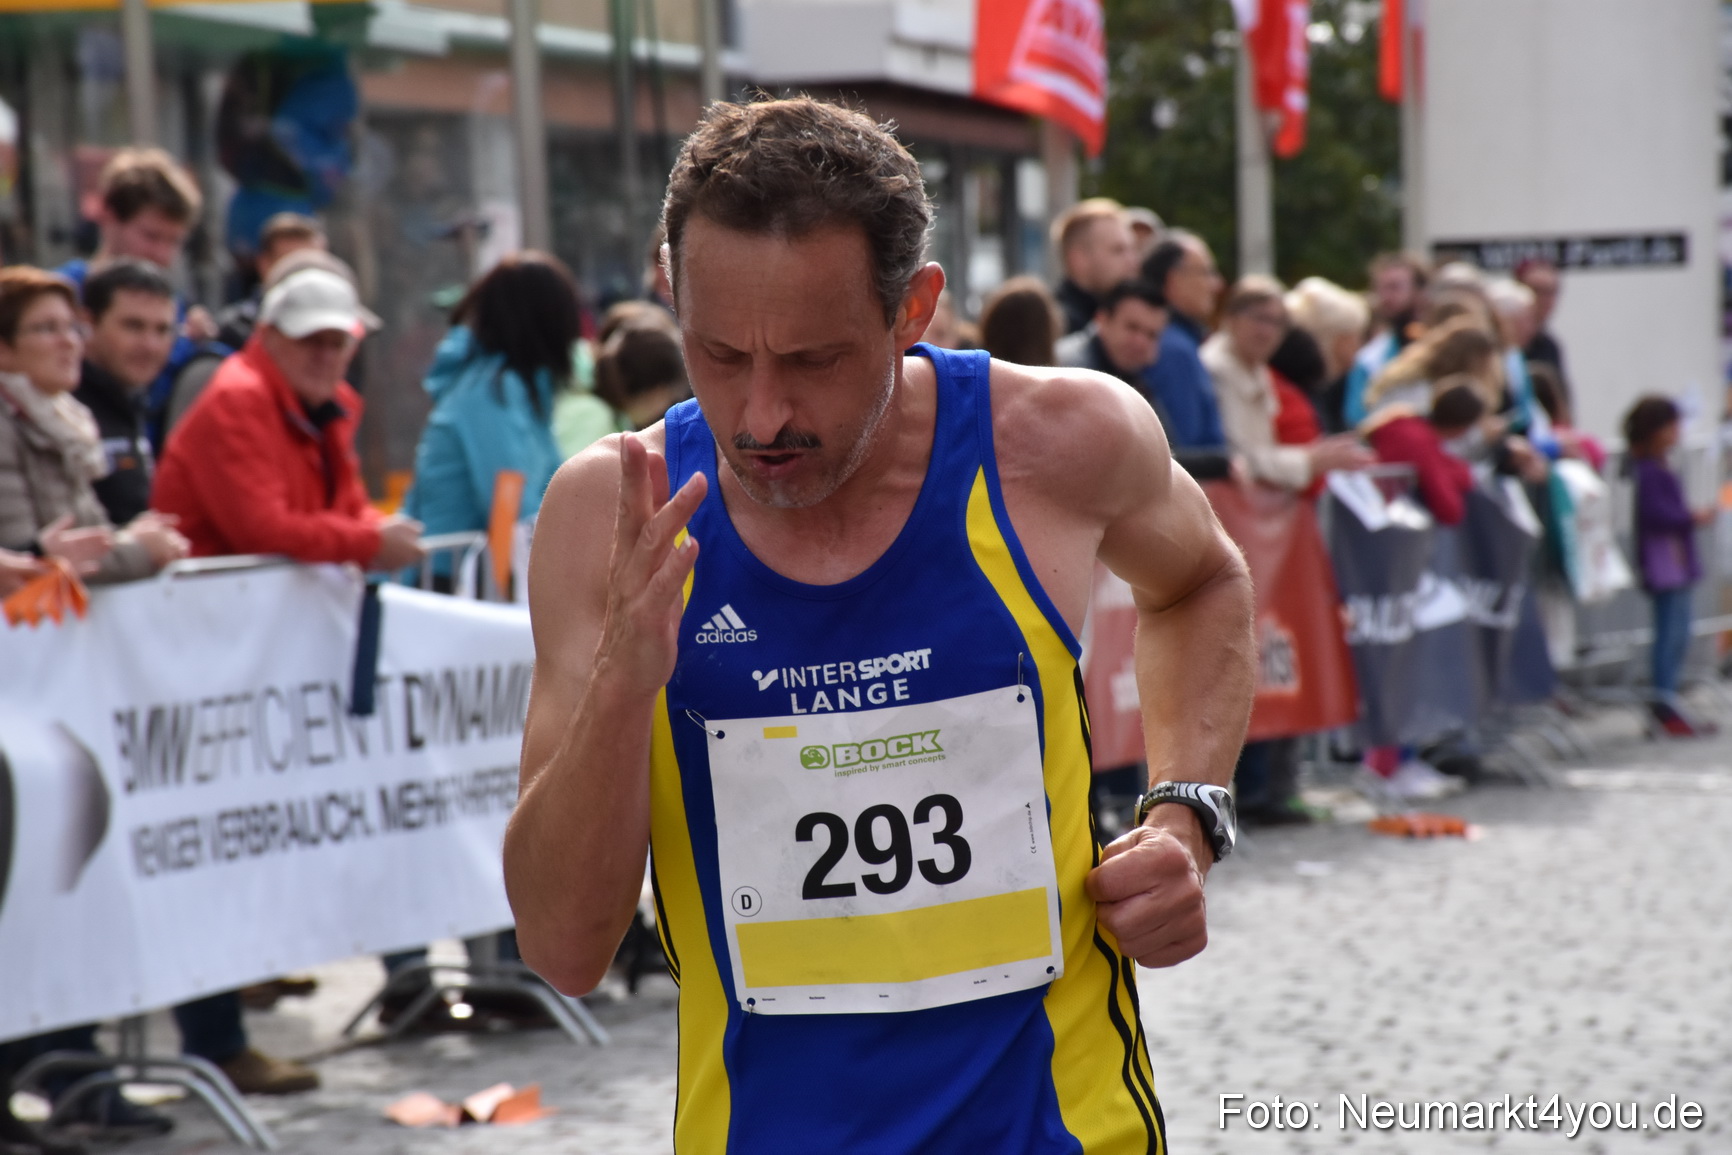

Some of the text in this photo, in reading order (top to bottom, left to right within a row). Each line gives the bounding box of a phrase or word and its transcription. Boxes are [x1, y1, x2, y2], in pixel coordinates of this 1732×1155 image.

[695, 628, 758, 644] adidas
[781, 647, 932, 689] INTERSPORT
[790, 678, 911, 714] LANGE
[832, 729, 945, 768] BOCK
[834, 753, 947, 778] inspired by smart concepts
[795, 793, 972, 901] 293
[740, 894, 752, 910] D
